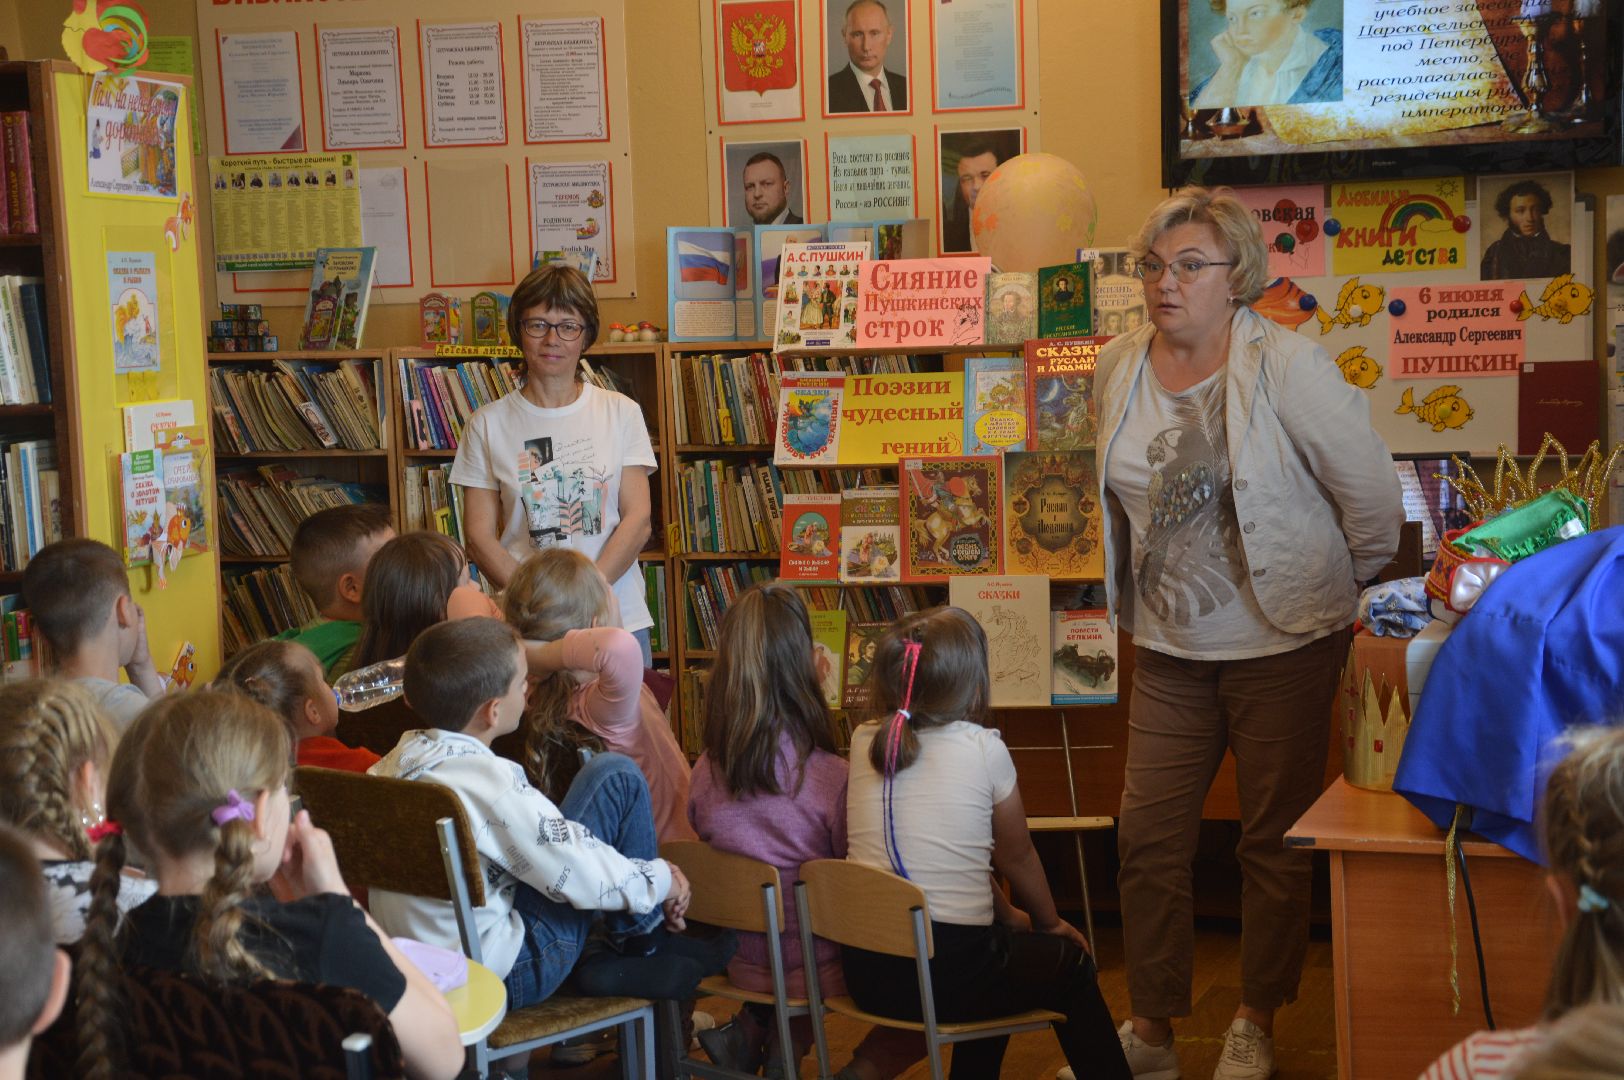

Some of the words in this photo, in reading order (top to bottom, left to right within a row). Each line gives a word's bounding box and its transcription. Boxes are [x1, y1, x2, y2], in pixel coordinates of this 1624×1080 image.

[1374, 4, 1450, 21] учебное
[1381, 40, 1414, 52] под
[1416, 54, 1484, 68] место,
[1358, 71, 1498, 89] располагалась
[1371, 87, 1482, 106] резиденция
[221, 157, 251, 171] Короткий
[252, 158, 268, 169] путь
[272, 153, 304, 167] быстрые
[835, 199, 858, 209] Россия
[864, 200, 872, 208] из
[873, 196, 911, 208] РОССИЯН!
[1250, 206, 1316, 223] овская
[1382, 247, 1458, 266] детства
[871, 263, 978, 292] Сияние
[864, 292, 983, 315] Пушкинских
[1418, 287, 1432, 305] 6
[1438, 288, 1505, 304] июня
[1426, 307, 1501, 323] родился
[864, 317, 944, 344] строк
[1393, 329, 1457, 346] Александр
[1460, 326, 1522, 345] Сергеевич
[483, 345, 523, 358] литера
[1401, 353, 1519, 374] ПУШКИН
[852, 377, 952, 396] Поэзии
[842, 401, 963, 426] чудесный
[881, 436, 953, 455] гений
[1040, 498, 1068, 514] Руслан
[978, 590, 1021, 601] СКАЗКИ
[1066, 634, 1103, 645] БЕЛКИНА
